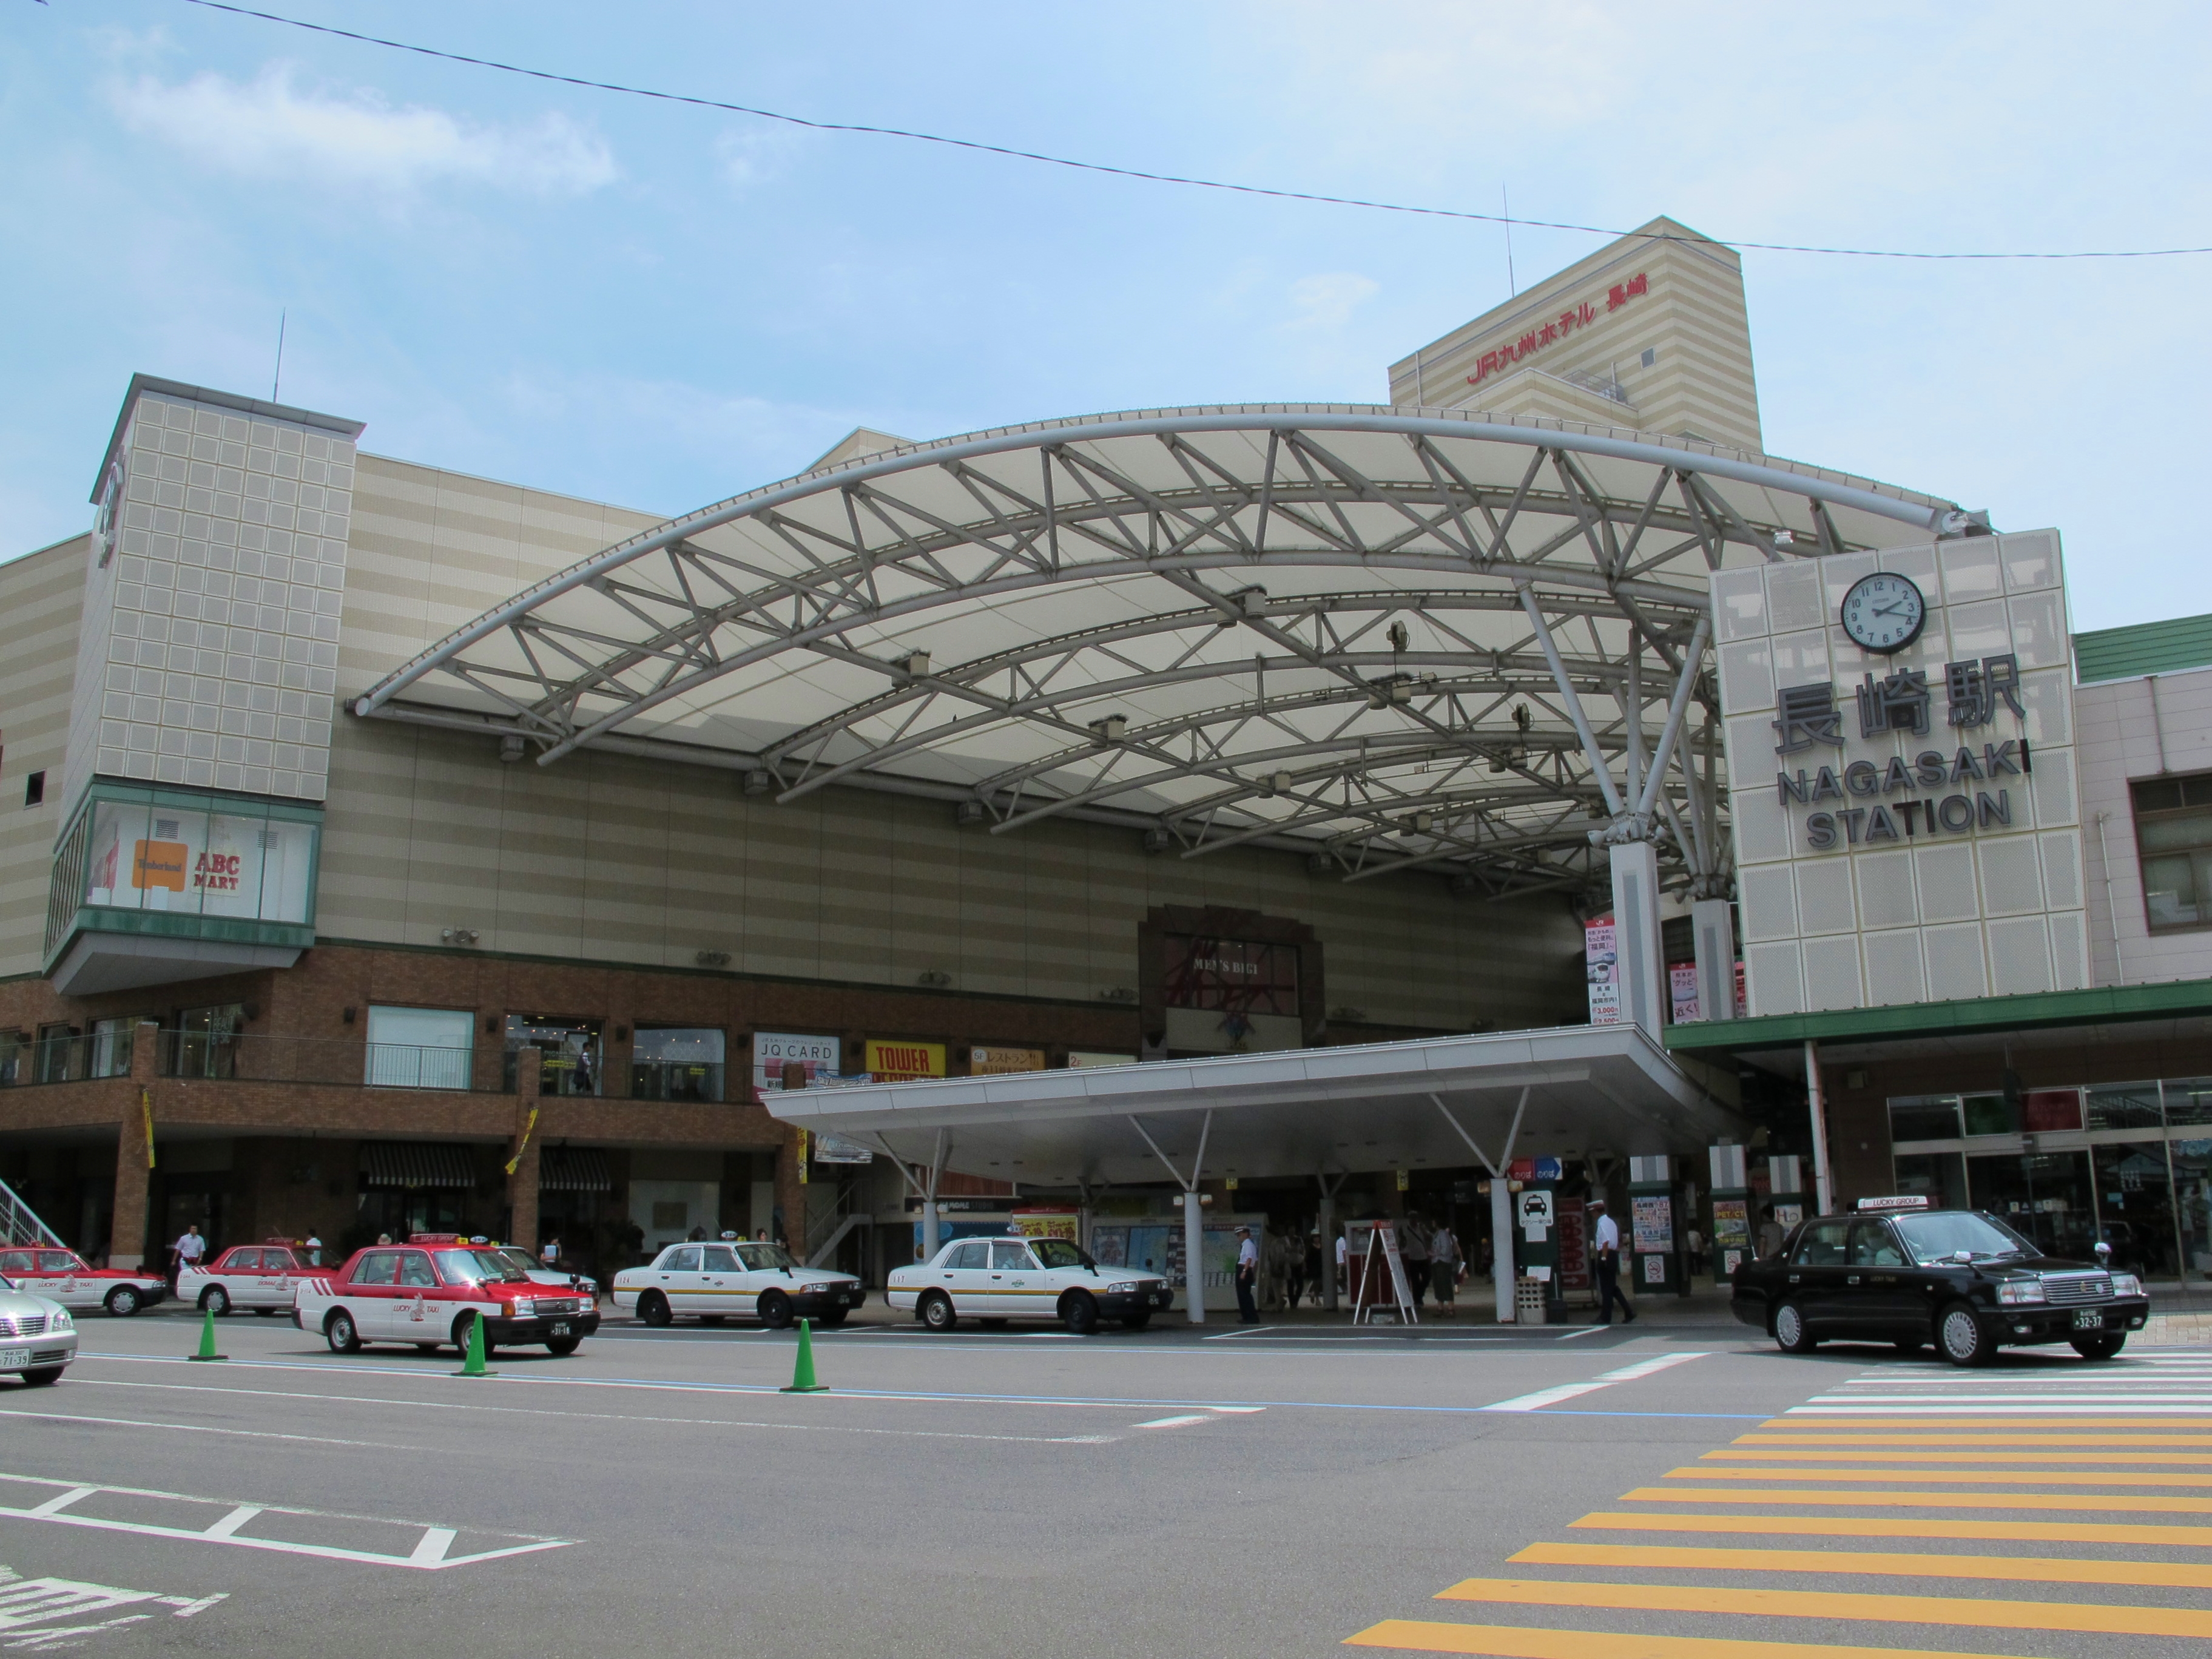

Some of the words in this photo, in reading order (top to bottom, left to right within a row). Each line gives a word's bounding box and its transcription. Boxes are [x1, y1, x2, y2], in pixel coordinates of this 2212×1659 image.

[1466, 301, 1596, 385] JR九州ホテル
[1607, 273, 1648, 314] 長崎
[1874, 581, 1884, 591] 12
[1892, 583, 1895, 592] 1
[1861, 587, 1869, 597] 11
[1902, 590, 1908, 600] 2
[1852, 598, 1861, 609] 10
[1907, 603, 1914, 612] 3
[1851, 612, 1858, 621] 9
[1905, 617, 1913, 625] 4
[1856, 624, 1863, 634] 8
[1896, 627, 1903, 637] 5
[1867, 632, 1874, 642] 7
[1883, 634, 1889, 643] 6
[1772, 653, 2026, 755] 長崎駅
[1777, 738, 2032, 806] NAGASAKI
[1807, 789, 2011, 848] STATION
[195, 853, 240, 875] ABC
[194, 874, 239, 890] MART
[1194, 958, 1229, 972] MEN'S
[1233, 962, 1258, 975] BIGI
[761, 1043, 781, 1057] JQ
[787, 1045, 832, 1059] CARD
[876, 1047, 929, 1072] TOWER
[987, 1052, 1027, 1064] レストラン
[1070, 1056, 1082, 1067] 2F
[2080, 1316, 2102, 1328] 32-37
[3, 1356, 27, 1366] 71-39
